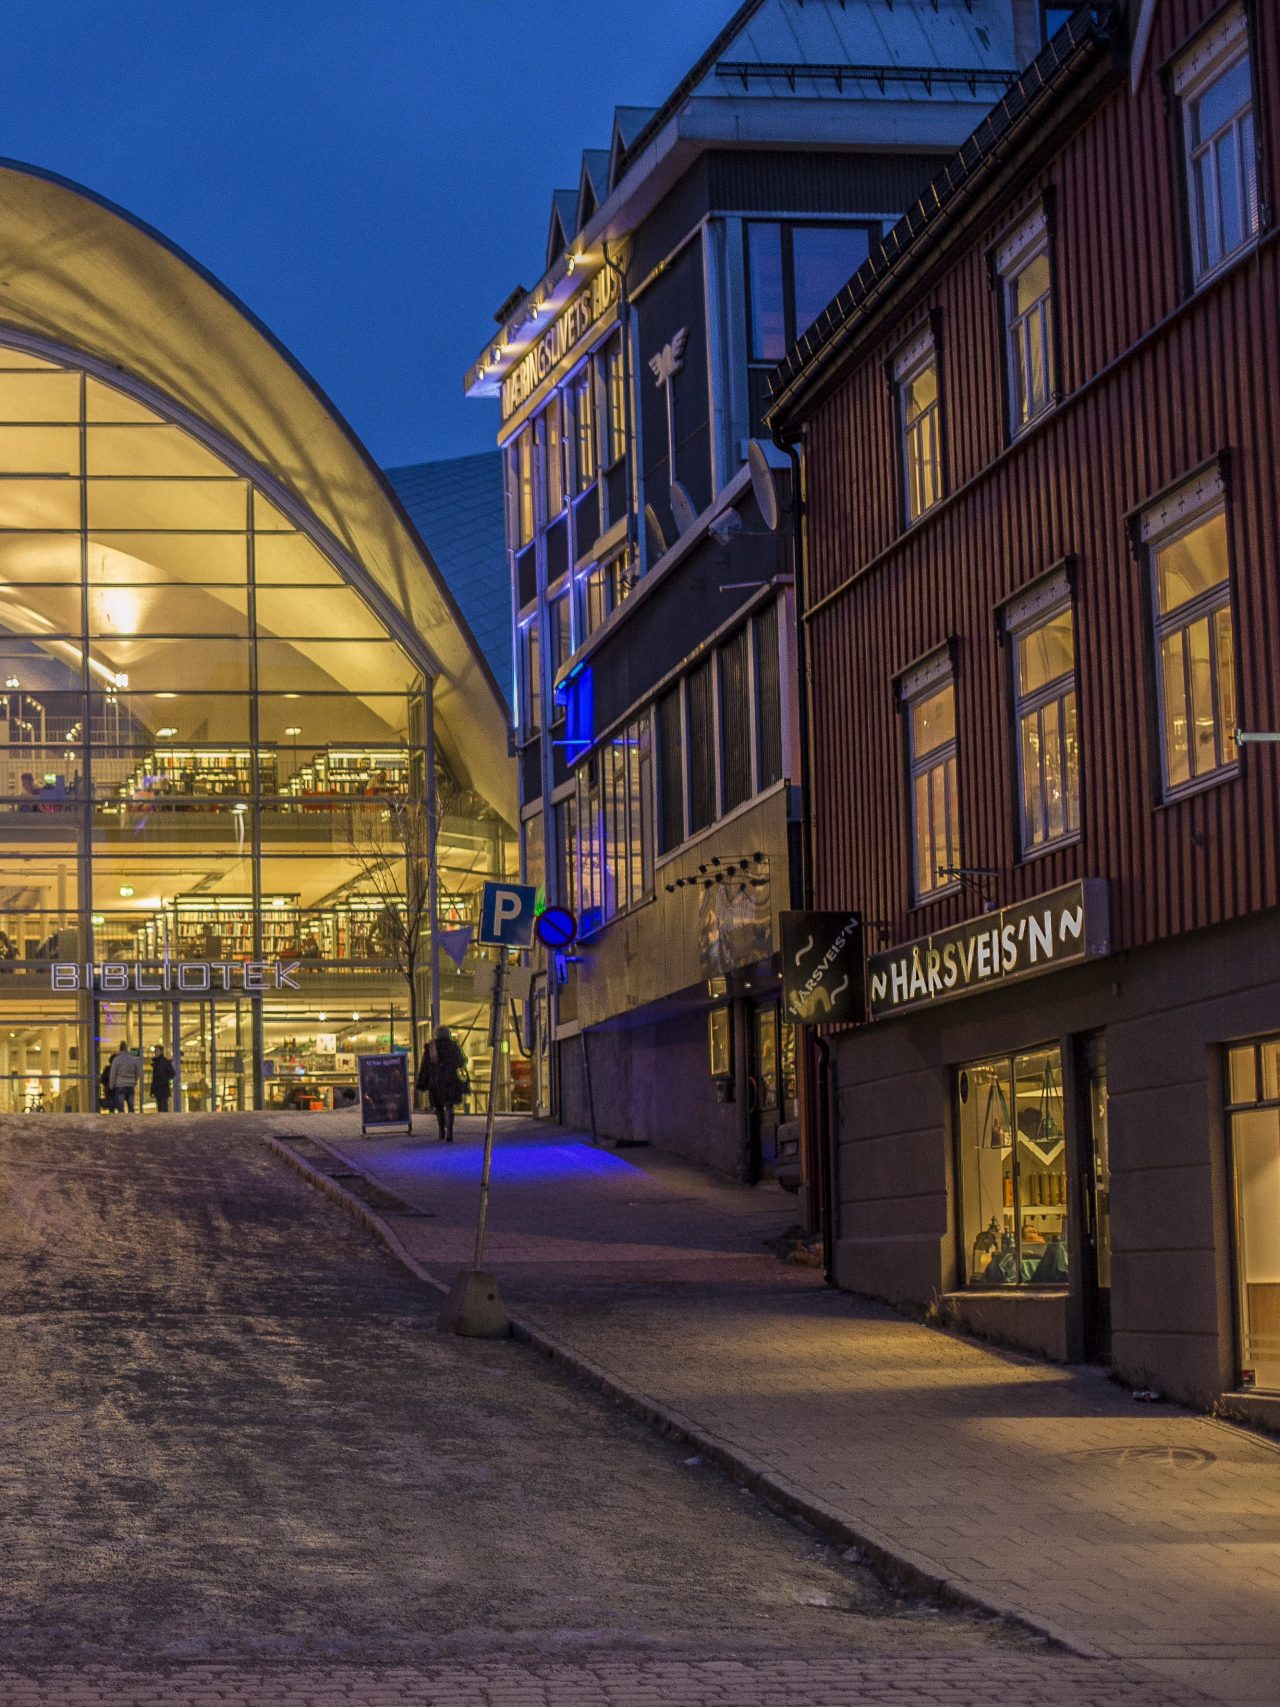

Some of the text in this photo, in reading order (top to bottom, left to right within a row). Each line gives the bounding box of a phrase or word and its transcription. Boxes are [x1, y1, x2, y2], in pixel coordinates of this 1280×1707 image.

[502, 289, 591, 420] NÆRINGSLIVETS
[493, 890, 522, 936] P
[51, 961, 301, 991] BIBLIOTEK
[890, 910, 1053, 1004] HÅRSVEIS'N
